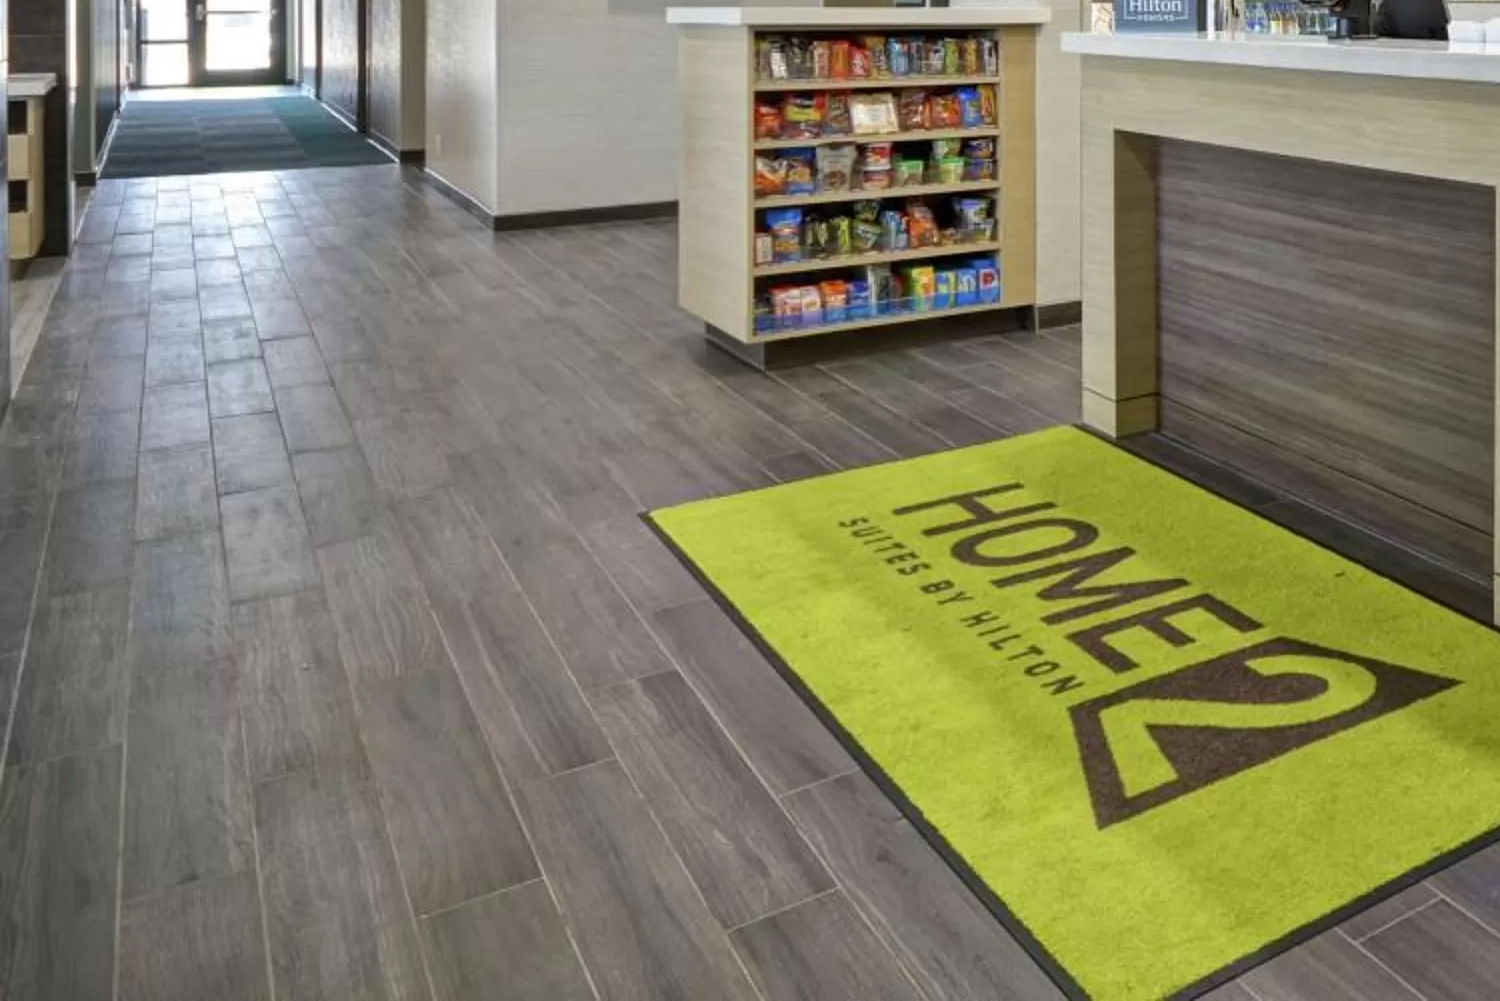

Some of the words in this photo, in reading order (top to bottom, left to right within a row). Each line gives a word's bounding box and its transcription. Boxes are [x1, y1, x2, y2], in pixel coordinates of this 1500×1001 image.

[837, 516, 933, 576] SUITES
[919, 579, 976, 606] BY
[959, 610, 1086, 696] HILTON
